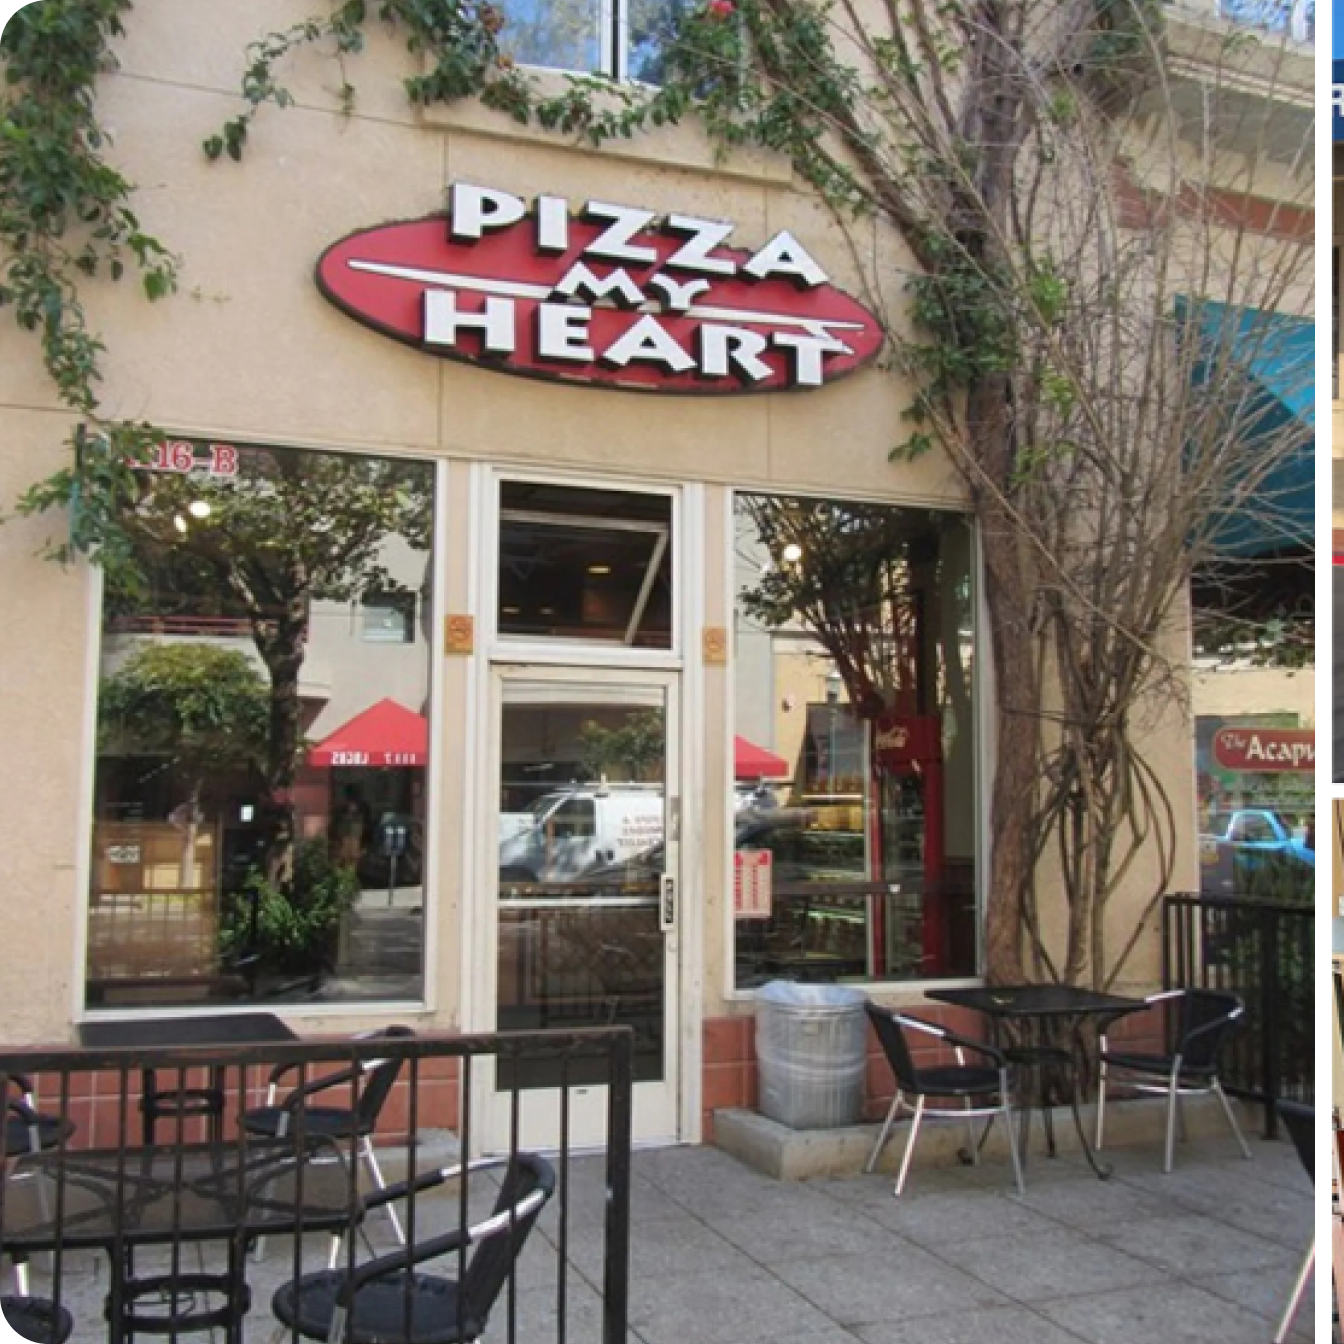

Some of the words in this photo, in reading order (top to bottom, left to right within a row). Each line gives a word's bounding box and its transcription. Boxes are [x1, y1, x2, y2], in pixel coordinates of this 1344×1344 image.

[449, 181, 829, 287] PIZZA
[551, 261, 711, 312] MY
[421, 289, 846, 386] HEART
